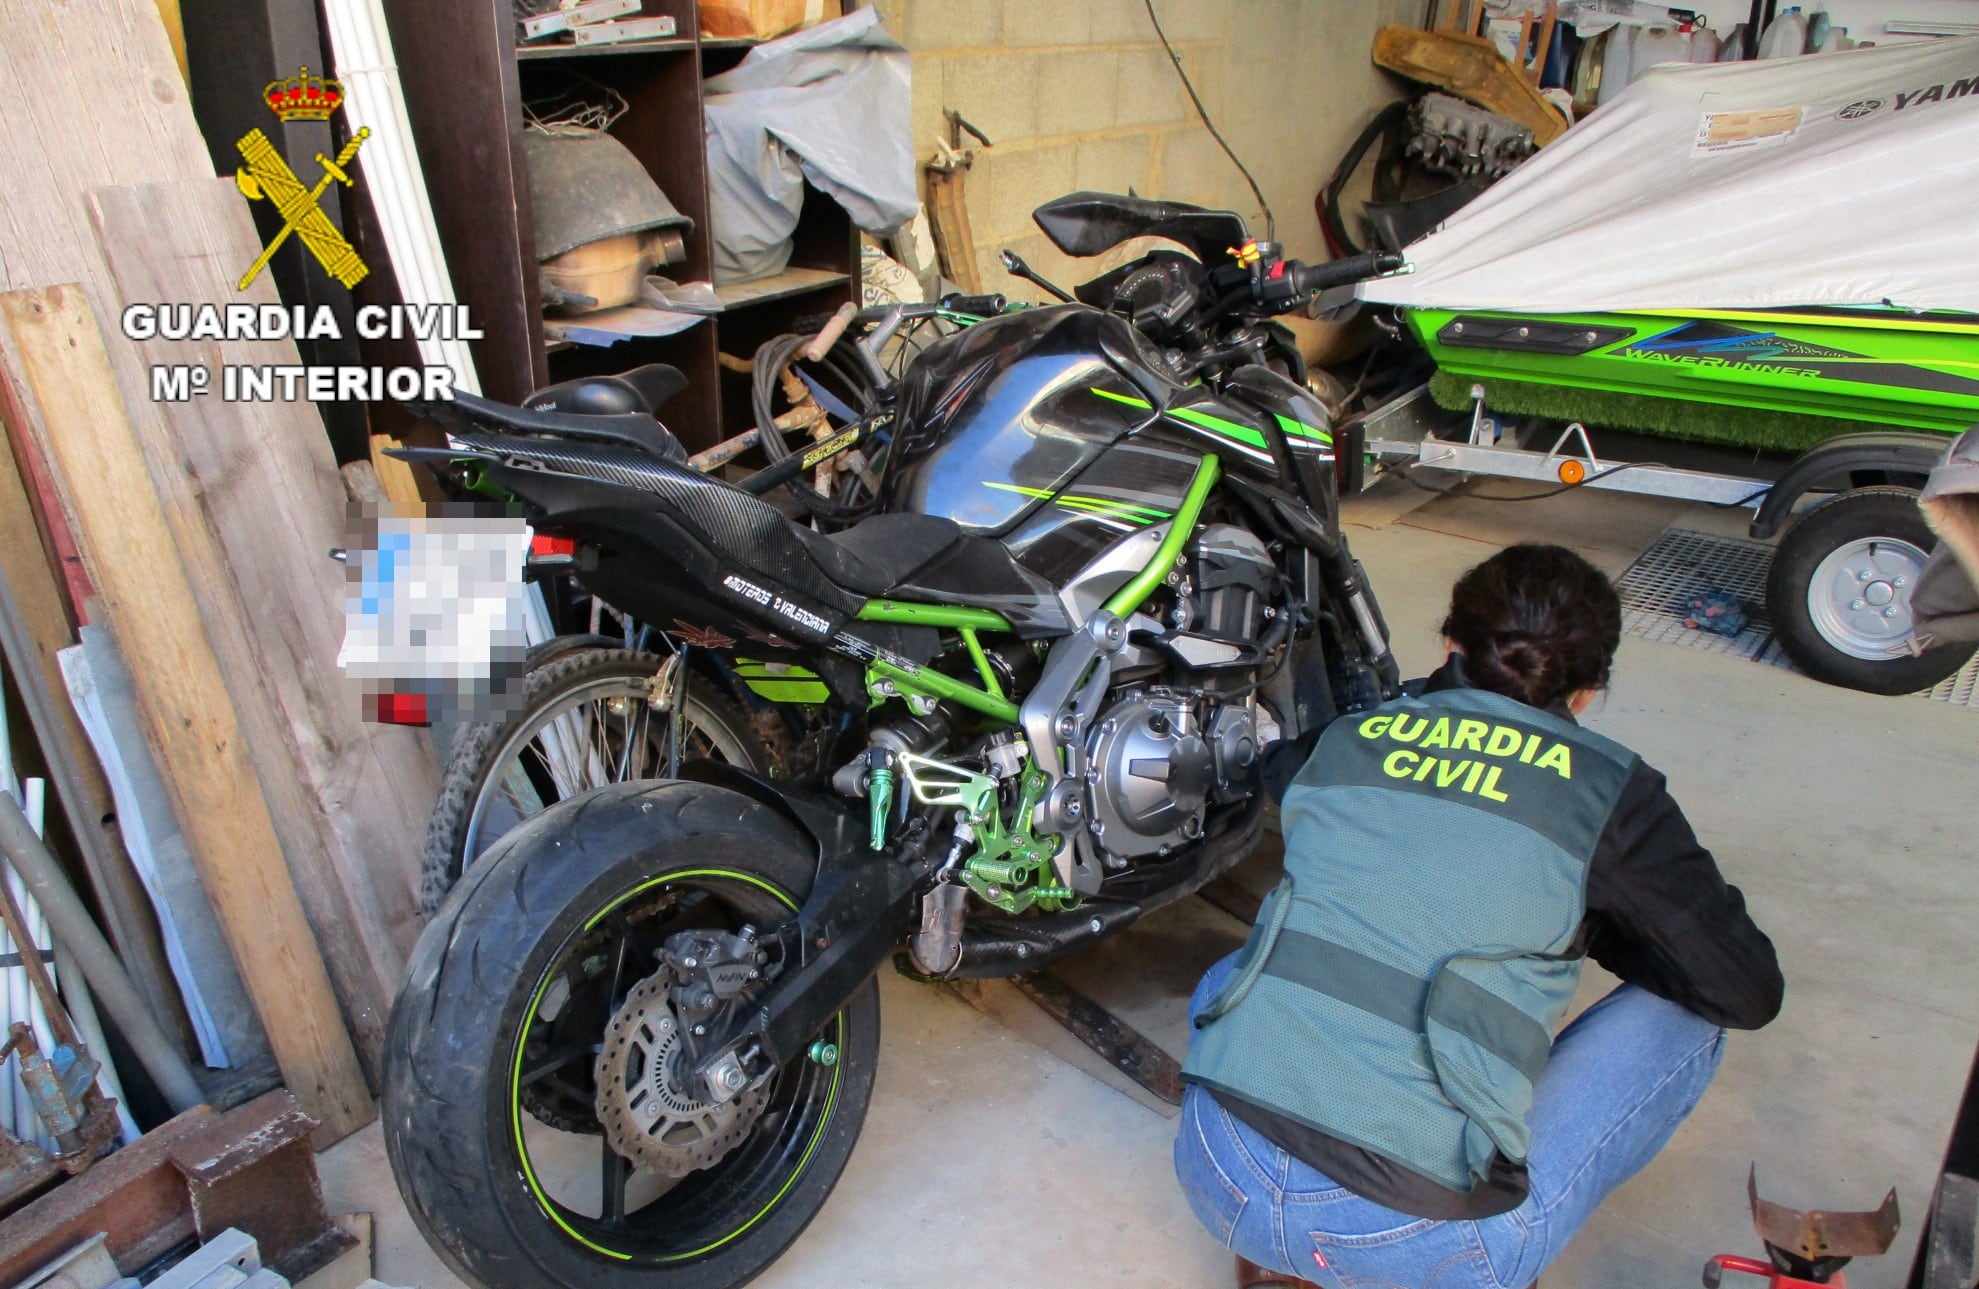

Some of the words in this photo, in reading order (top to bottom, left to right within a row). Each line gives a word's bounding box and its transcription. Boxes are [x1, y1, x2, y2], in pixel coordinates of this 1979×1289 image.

[1893, 76, 1979, 111] YAM
[1359, 713, 1571, 779] GUARDIA
[1383, 750, 1509, 802] CIVIL
